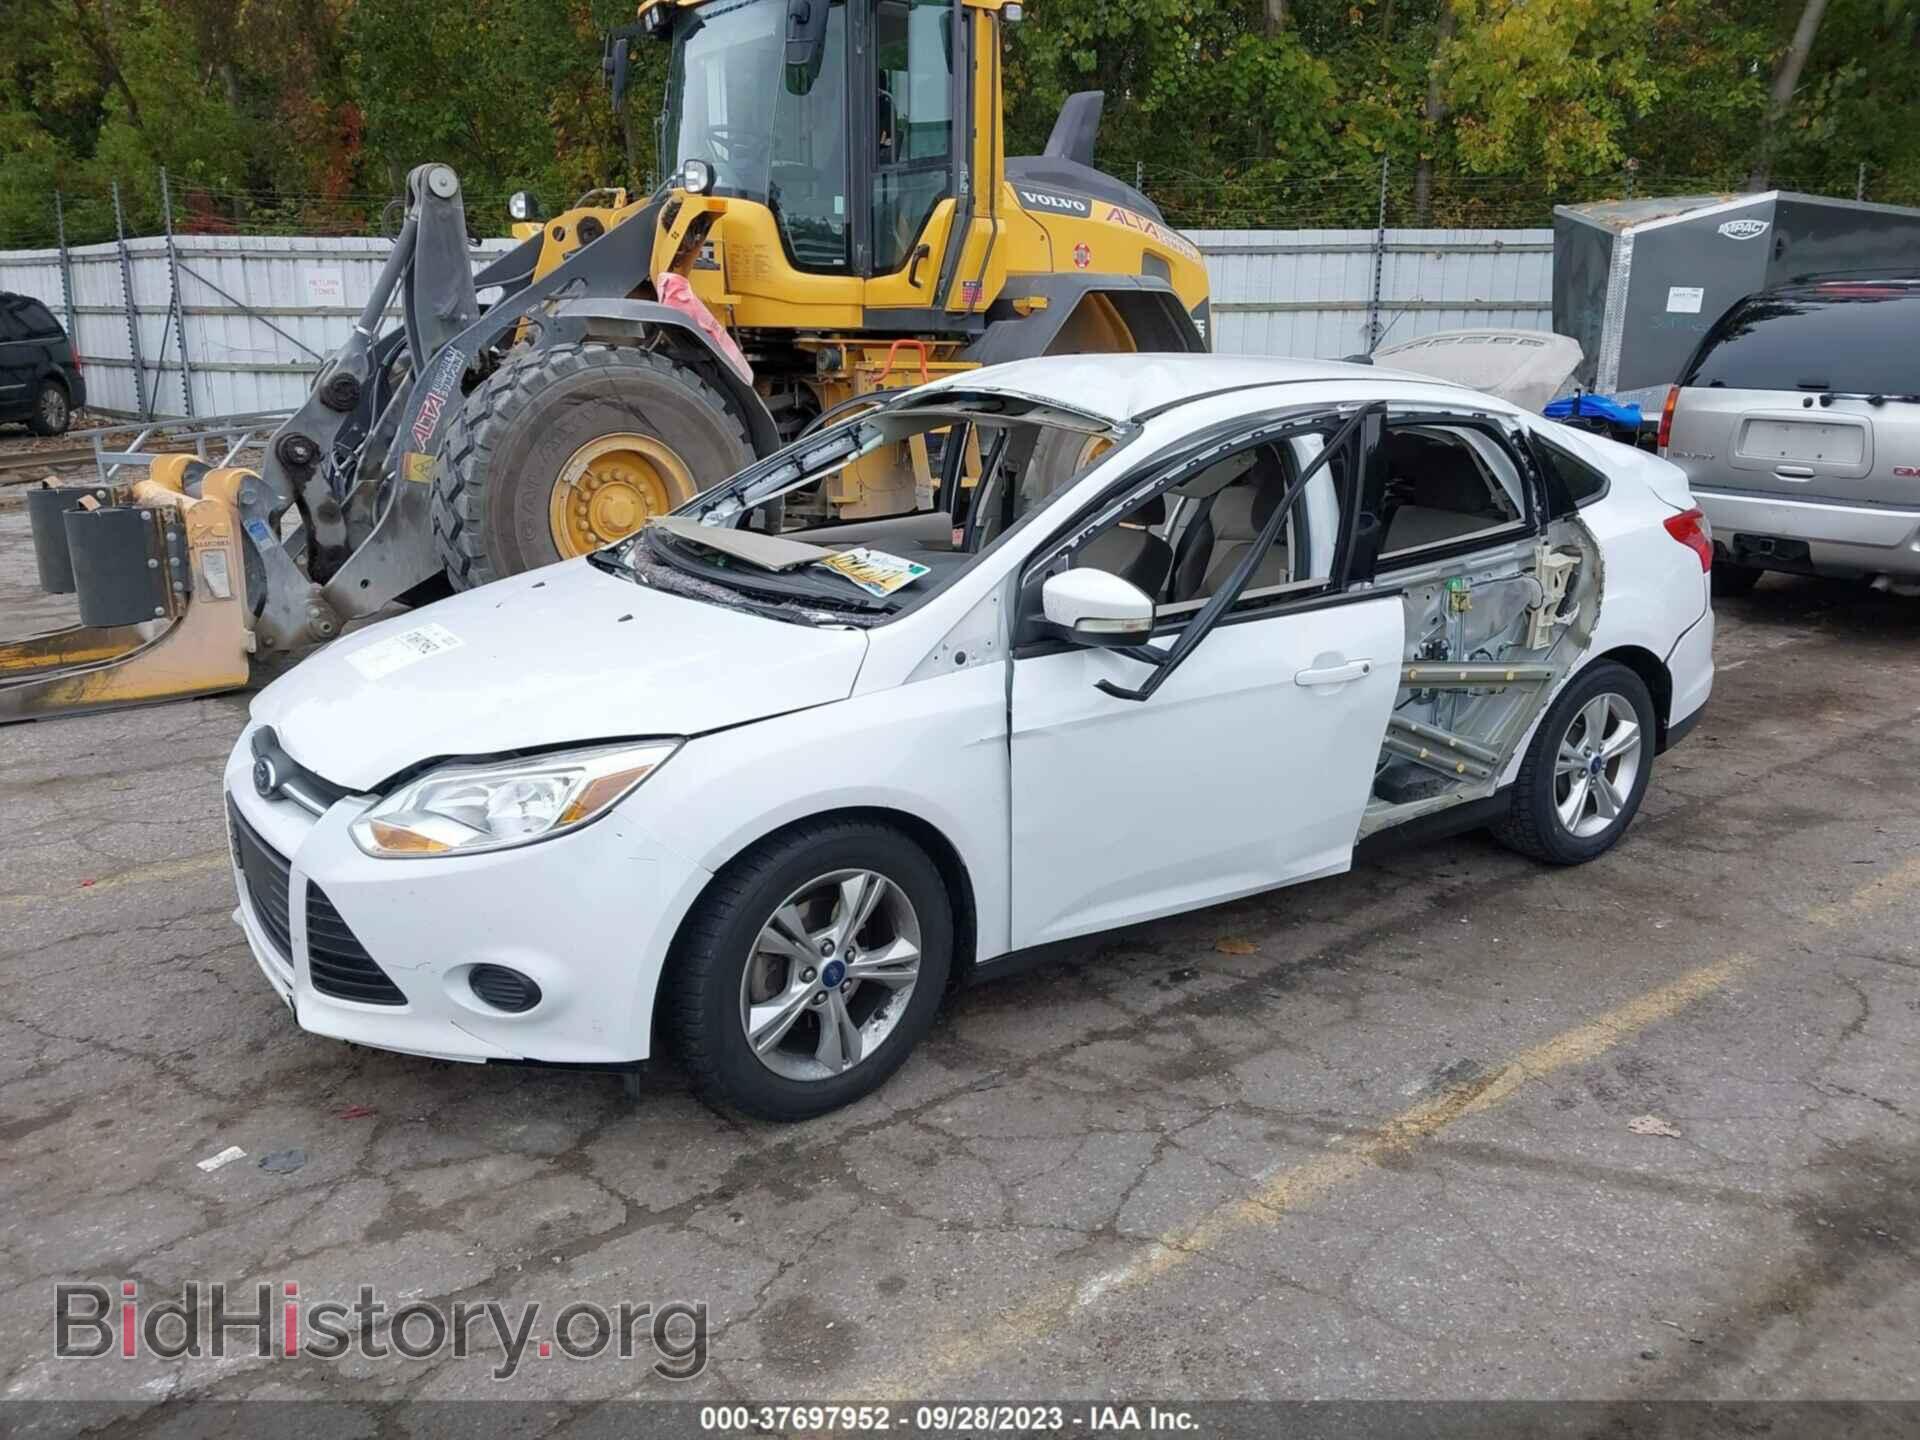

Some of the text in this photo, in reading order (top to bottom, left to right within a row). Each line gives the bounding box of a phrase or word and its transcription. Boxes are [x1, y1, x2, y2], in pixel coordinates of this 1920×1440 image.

[1021, 191, 1086, 212] VOLVO
[1106, 207, 1160, 239] ALTA
[411, 391, 447, 453] ALTA
